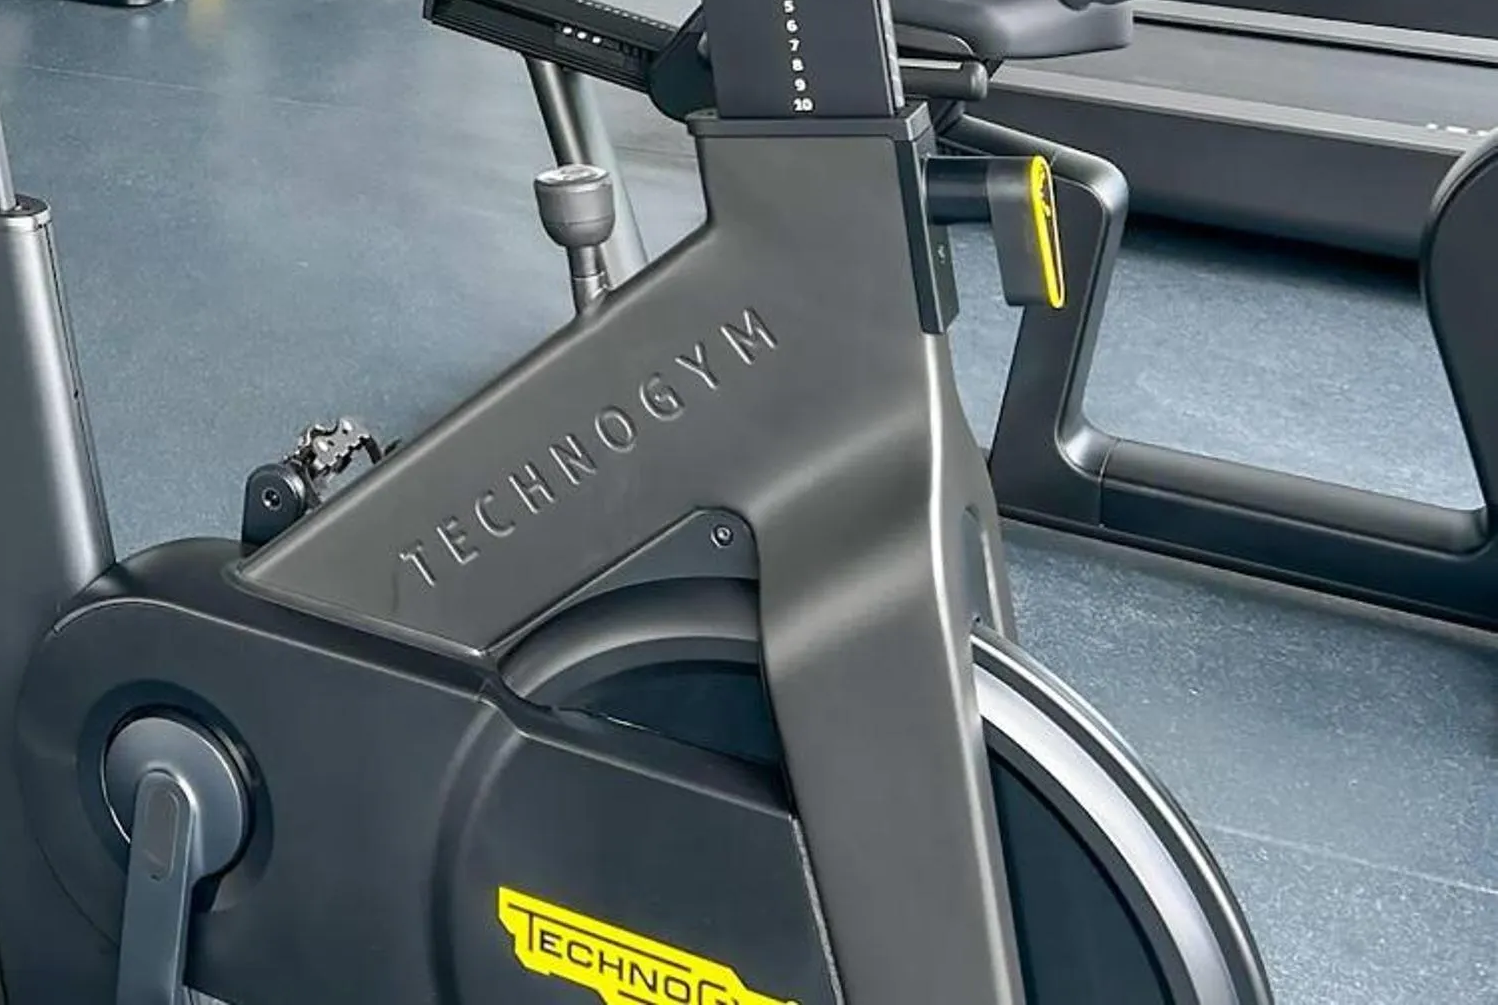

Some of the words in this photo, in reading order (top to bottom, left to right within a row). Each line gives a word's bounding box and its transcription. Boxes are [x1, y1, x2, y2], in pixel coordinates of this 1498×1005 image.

[783, 0, 795, 13] 5
[786, 19, 798, 33] 6
[788, 38, 800, 52] 7
[792, 58, 804, 72] 8
[794, 78, 806, 92] 9
[793, 98, 813, 111] 10
[399, 308, 778, 587] TECHNOGYM
[508, 902, 739, 1005] TECHNOG
